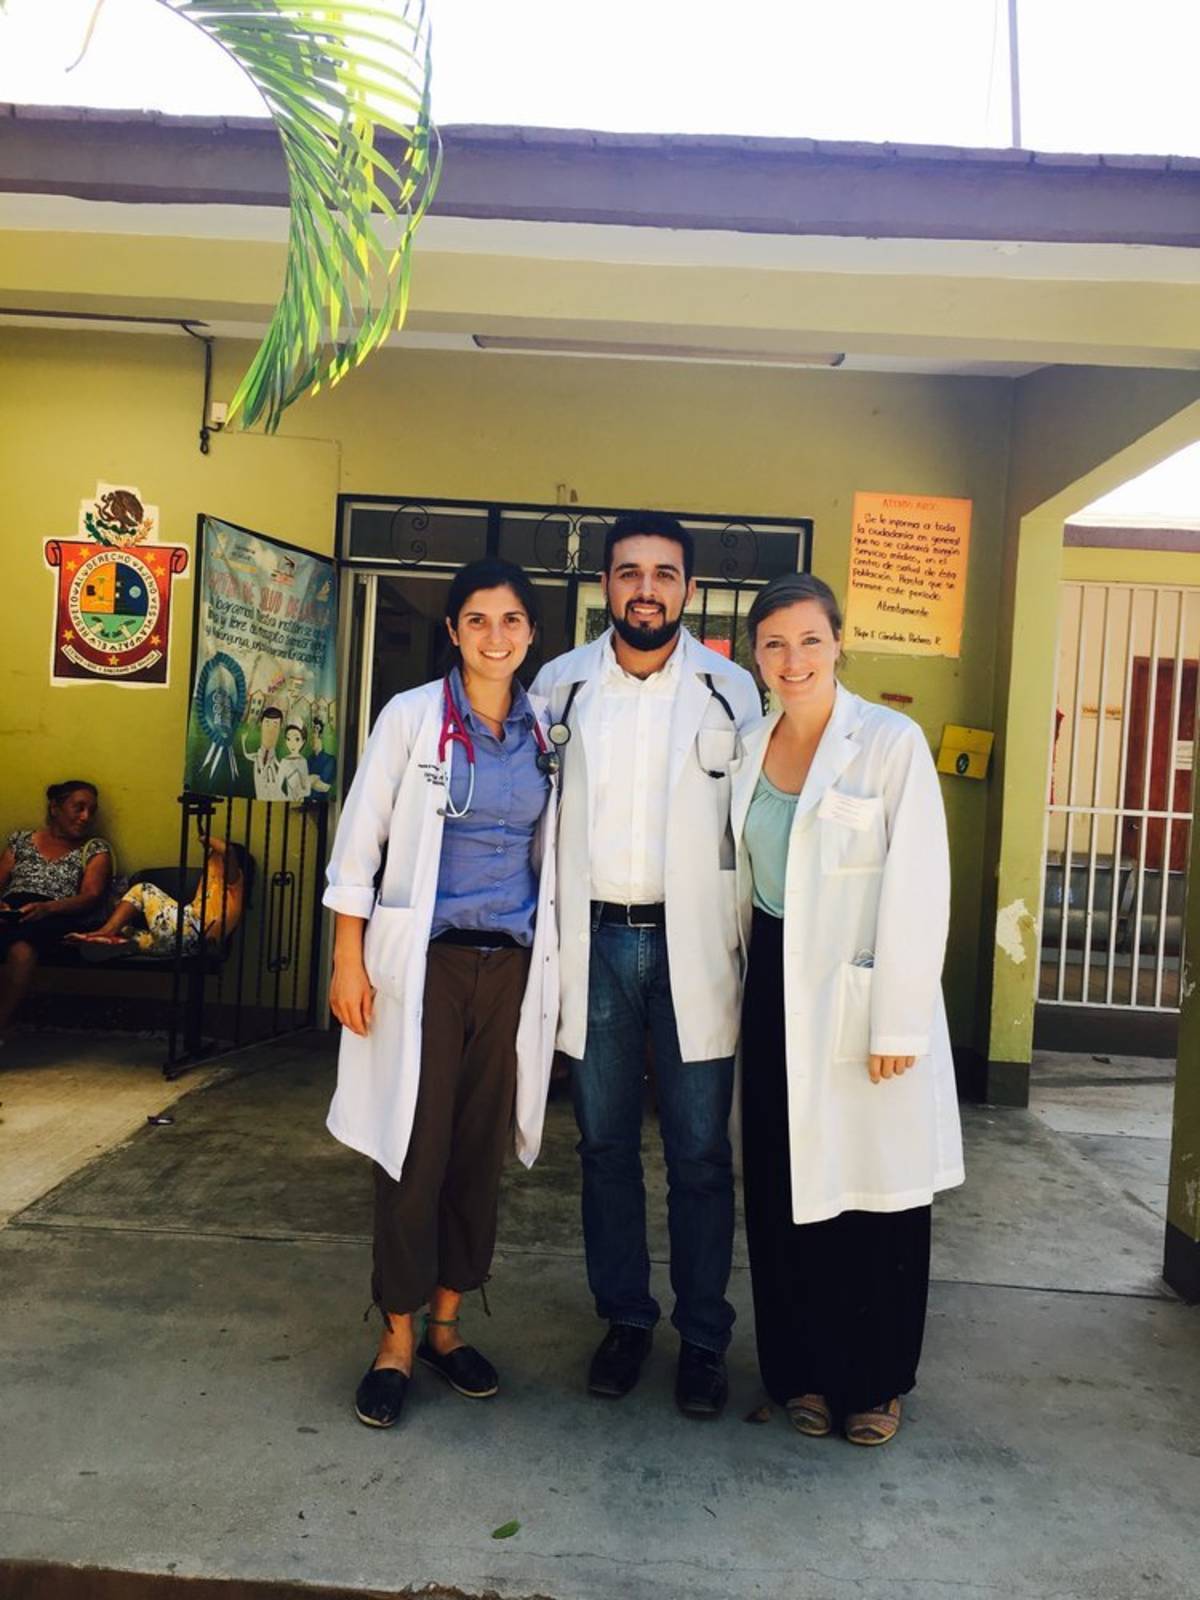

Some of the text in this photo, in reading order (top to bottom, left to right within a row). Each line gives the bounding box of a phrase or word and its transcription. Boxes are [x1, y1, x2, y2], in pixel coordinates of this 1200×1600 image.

[935, 522, 956, 533] toda
[70, 596, 90, 638] RESPETO
[86, 552, 131, 571] DERECHO
